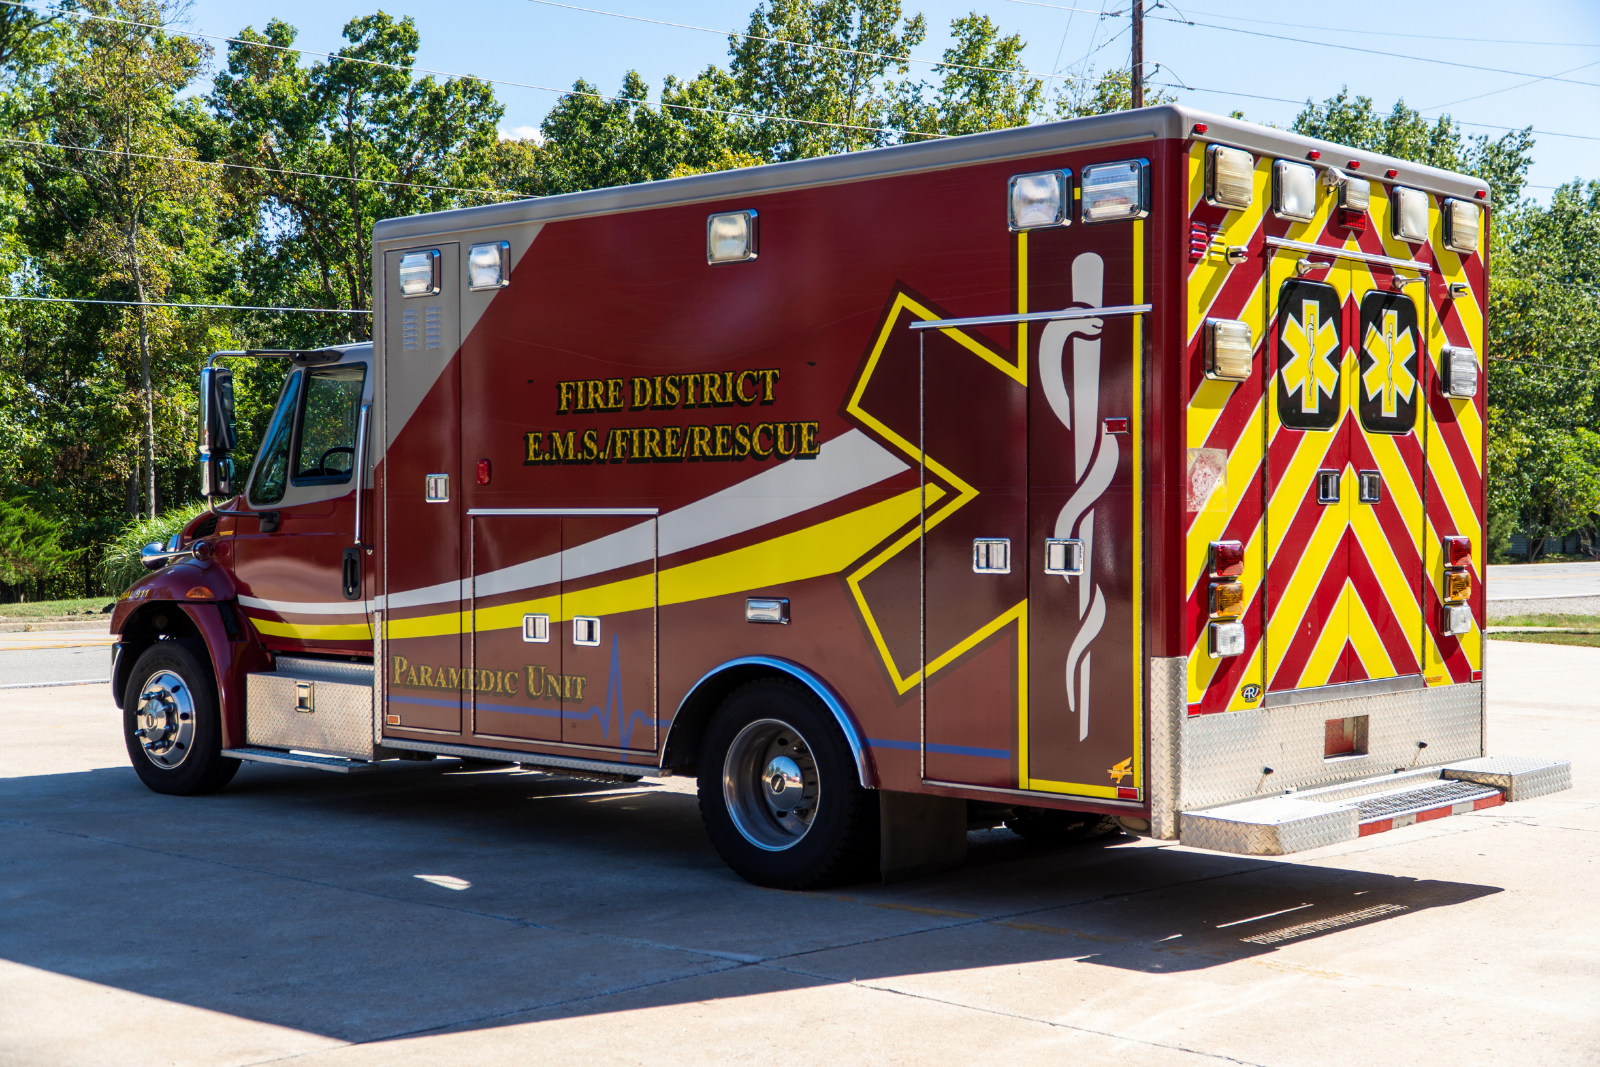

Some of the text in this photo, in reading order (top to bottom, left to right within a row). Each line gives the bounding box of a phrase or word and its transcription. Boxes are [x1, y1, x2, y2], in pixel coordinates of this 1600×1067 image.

[557, 368, 780, 413] FIRE DISTRICT
[135, 588, 150, 599] 911
